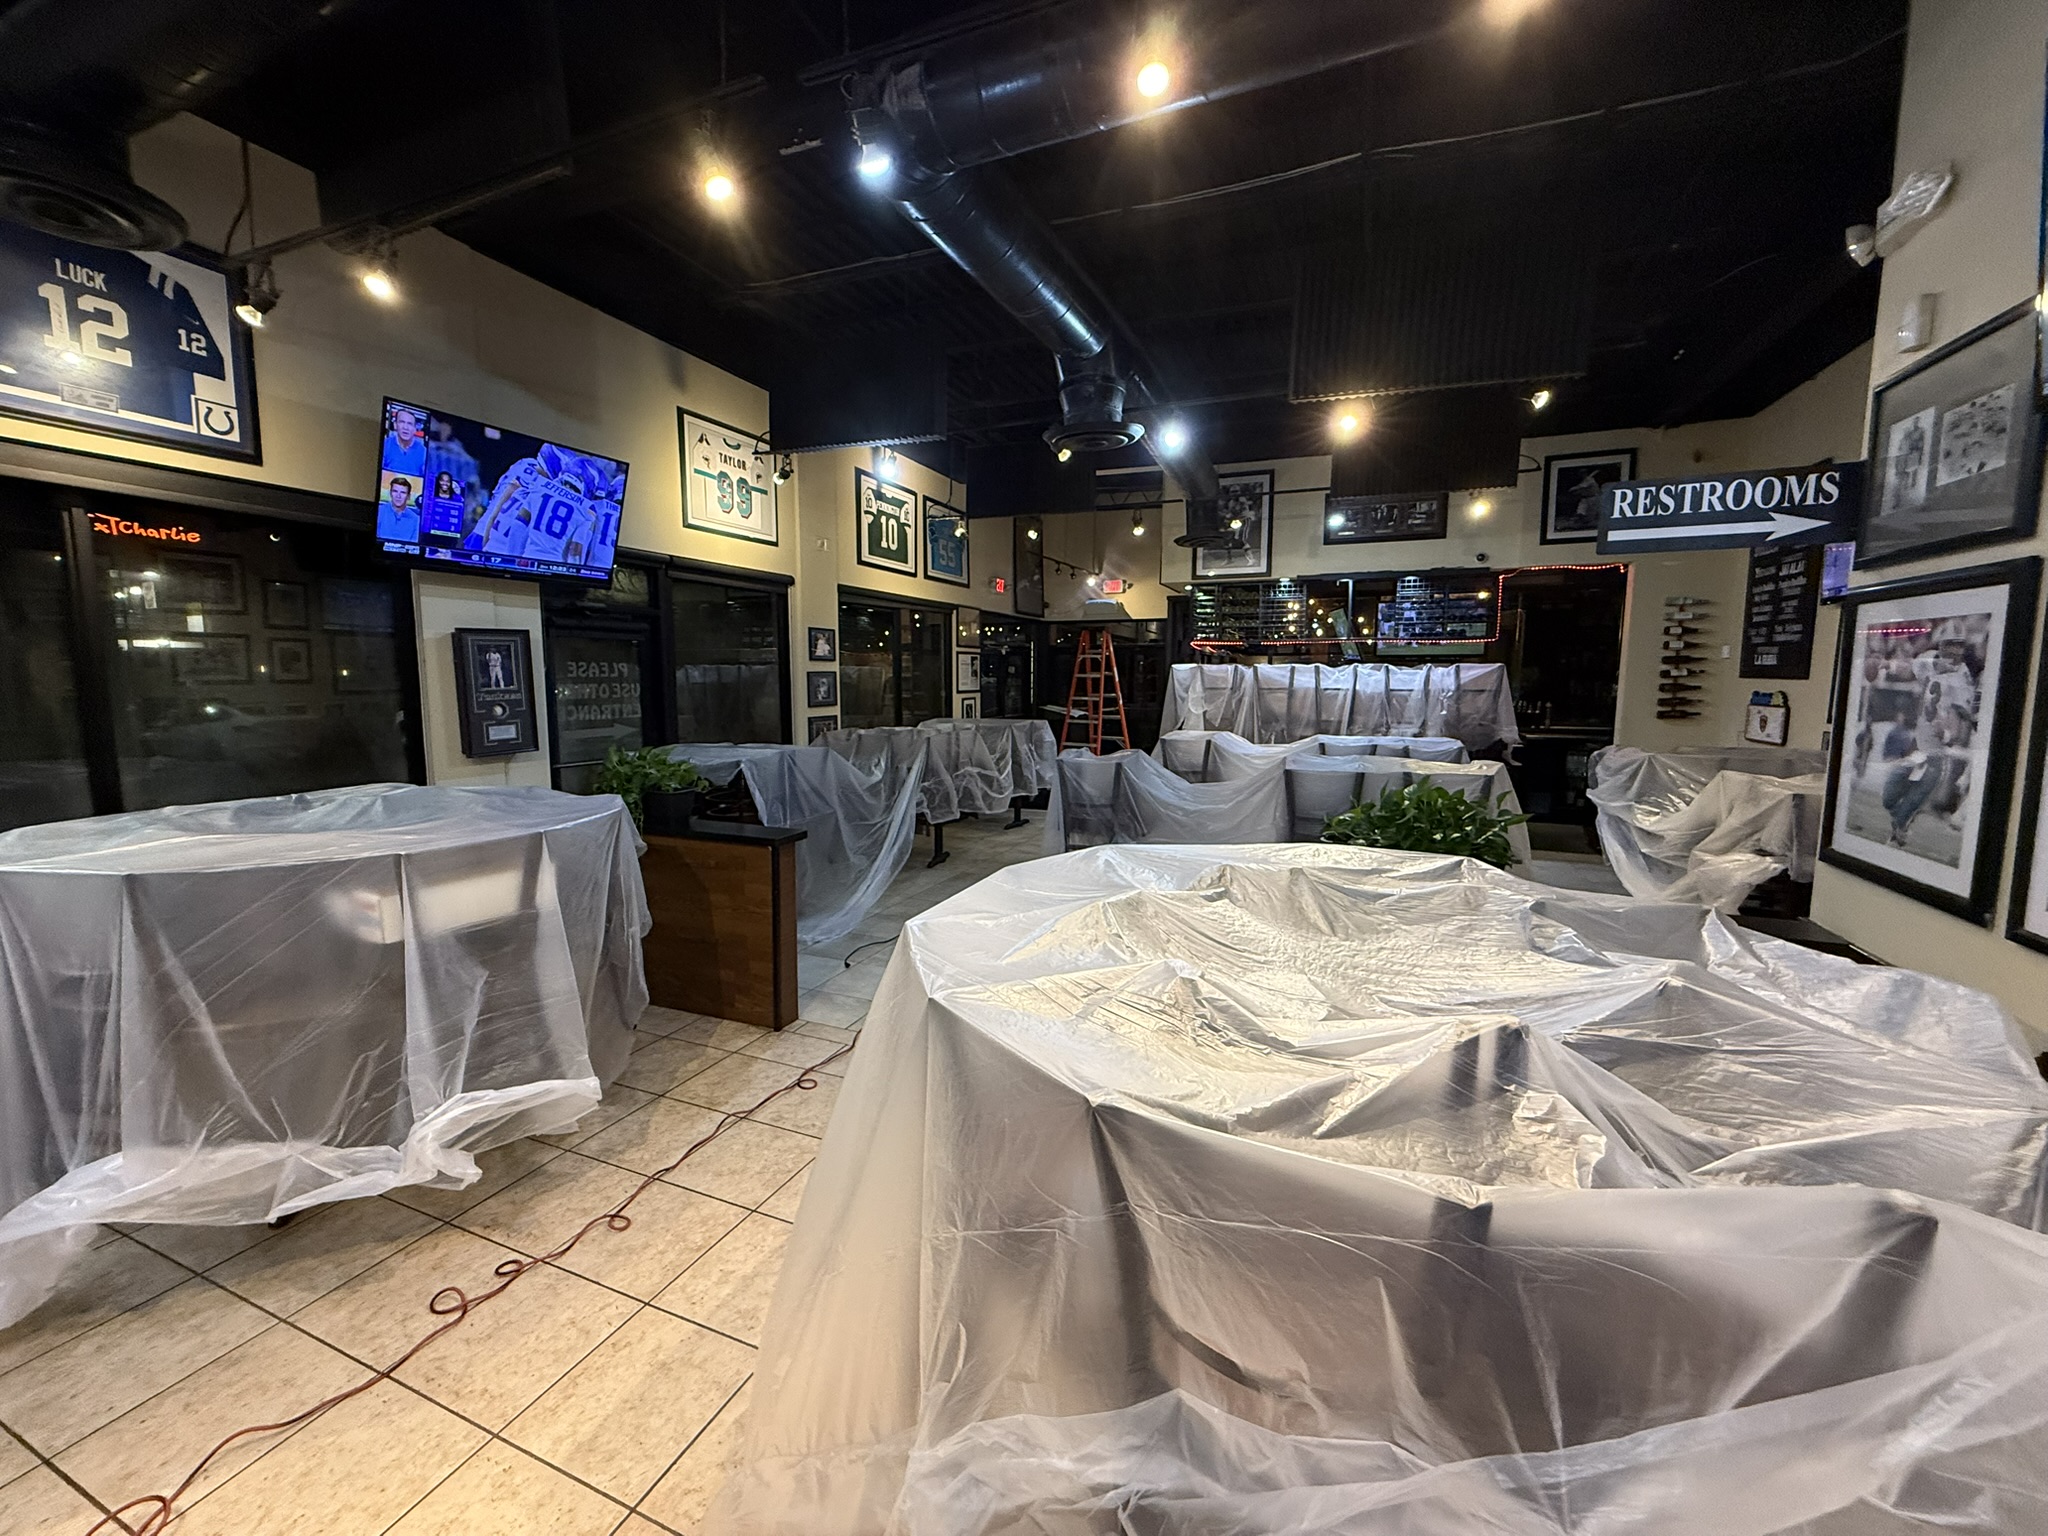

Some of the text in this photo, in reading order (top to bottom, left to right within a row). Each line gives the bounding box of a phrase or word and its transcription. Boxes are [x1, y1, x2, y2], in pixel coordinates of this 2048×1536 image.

[55, 257, 107, 292] LUCK
[37, 282, 133, 367] 12
[177, 328, 208, 357] 12
[719, 452, 747, 471] TAYLOR
[540, 480, 585, 506] JEFFERSON
[717, 470, 752, 519] 99
[1610, 471, 1841, 519] RESTROOMS
[533, 492, 575, 540] 18
[880, 515, 898, 551] 10
[938, 538, 957, 567] 55
